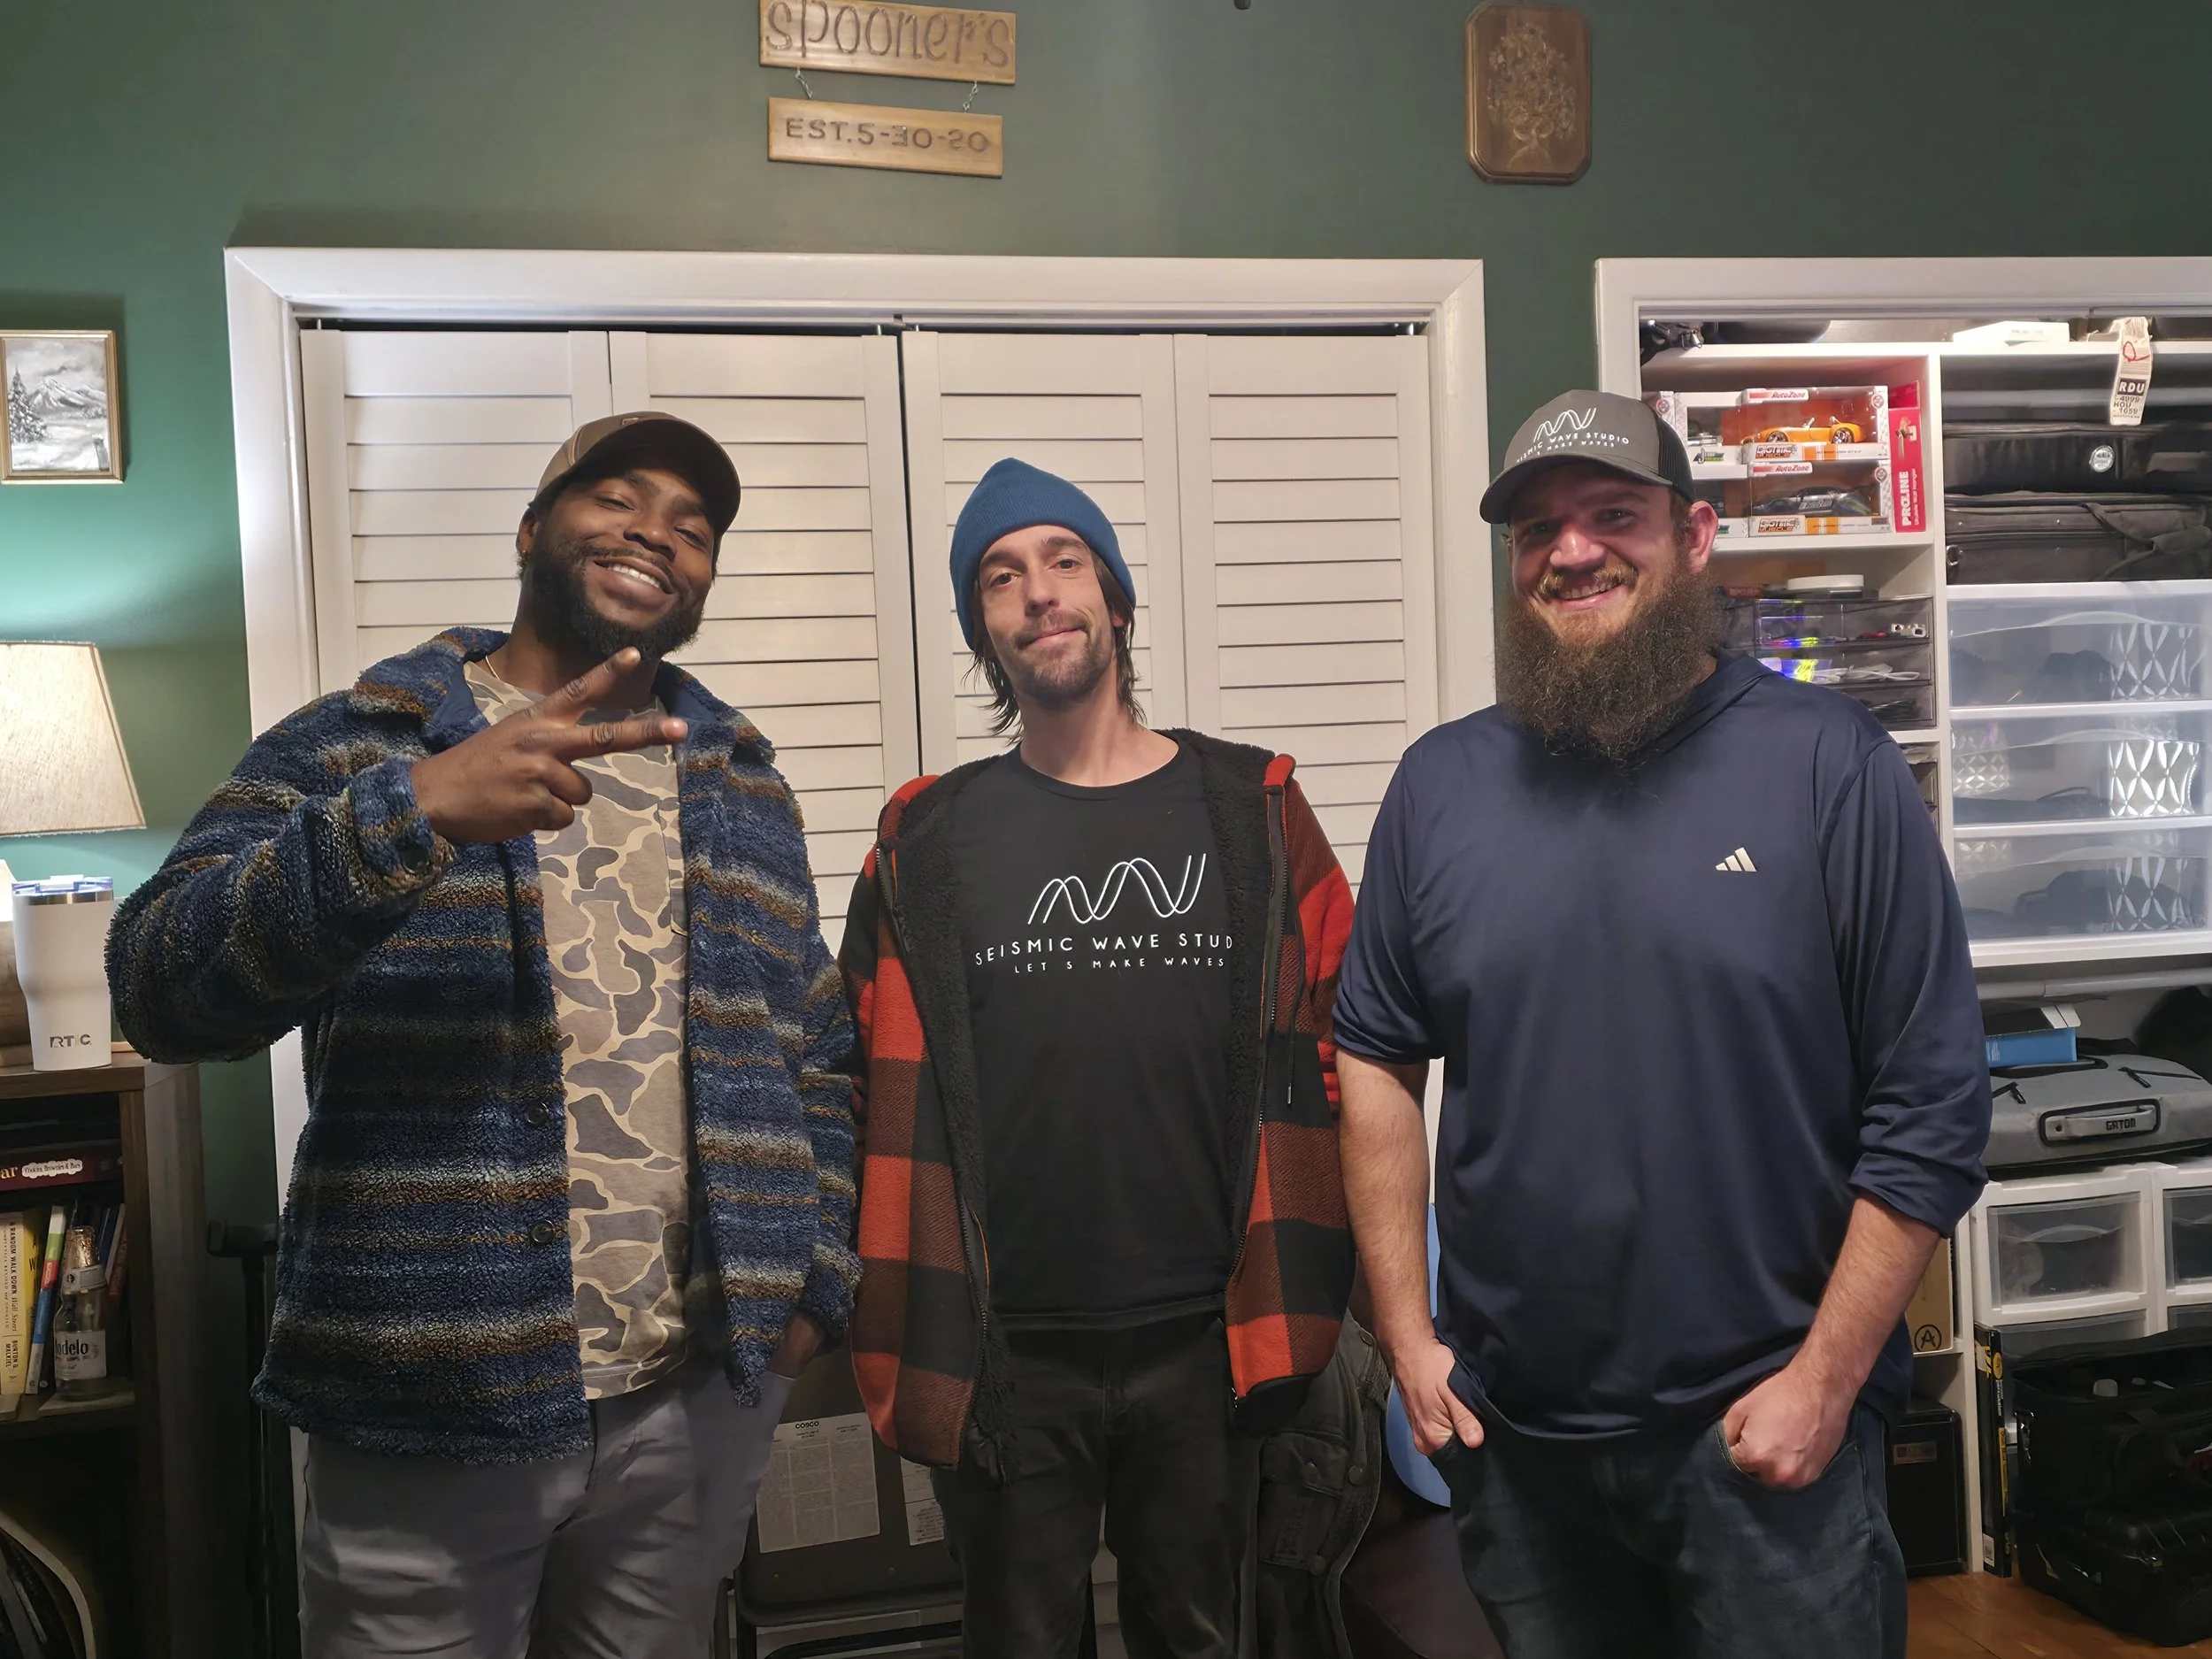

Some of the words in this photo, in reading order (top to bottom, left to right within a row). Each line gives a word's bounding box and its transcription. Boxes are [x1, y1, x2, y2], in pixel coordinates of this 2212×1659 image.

[2119, 381, 2145, 393] RDU
[1549, 432, 1578, 443] WAVE
[1586, 432, 1630, 444] STUDIO
[1899, 471, 1912, 526] PROLINE
[975, 937, 1073, 965] SEISMIC
[1093, 933, 1160, 950] WAVE
[1093, 957, 1146, 969] MAKE
[1164, 956, 1224, 967] WAVES
[55, 1339, 88, 1356] odelo
